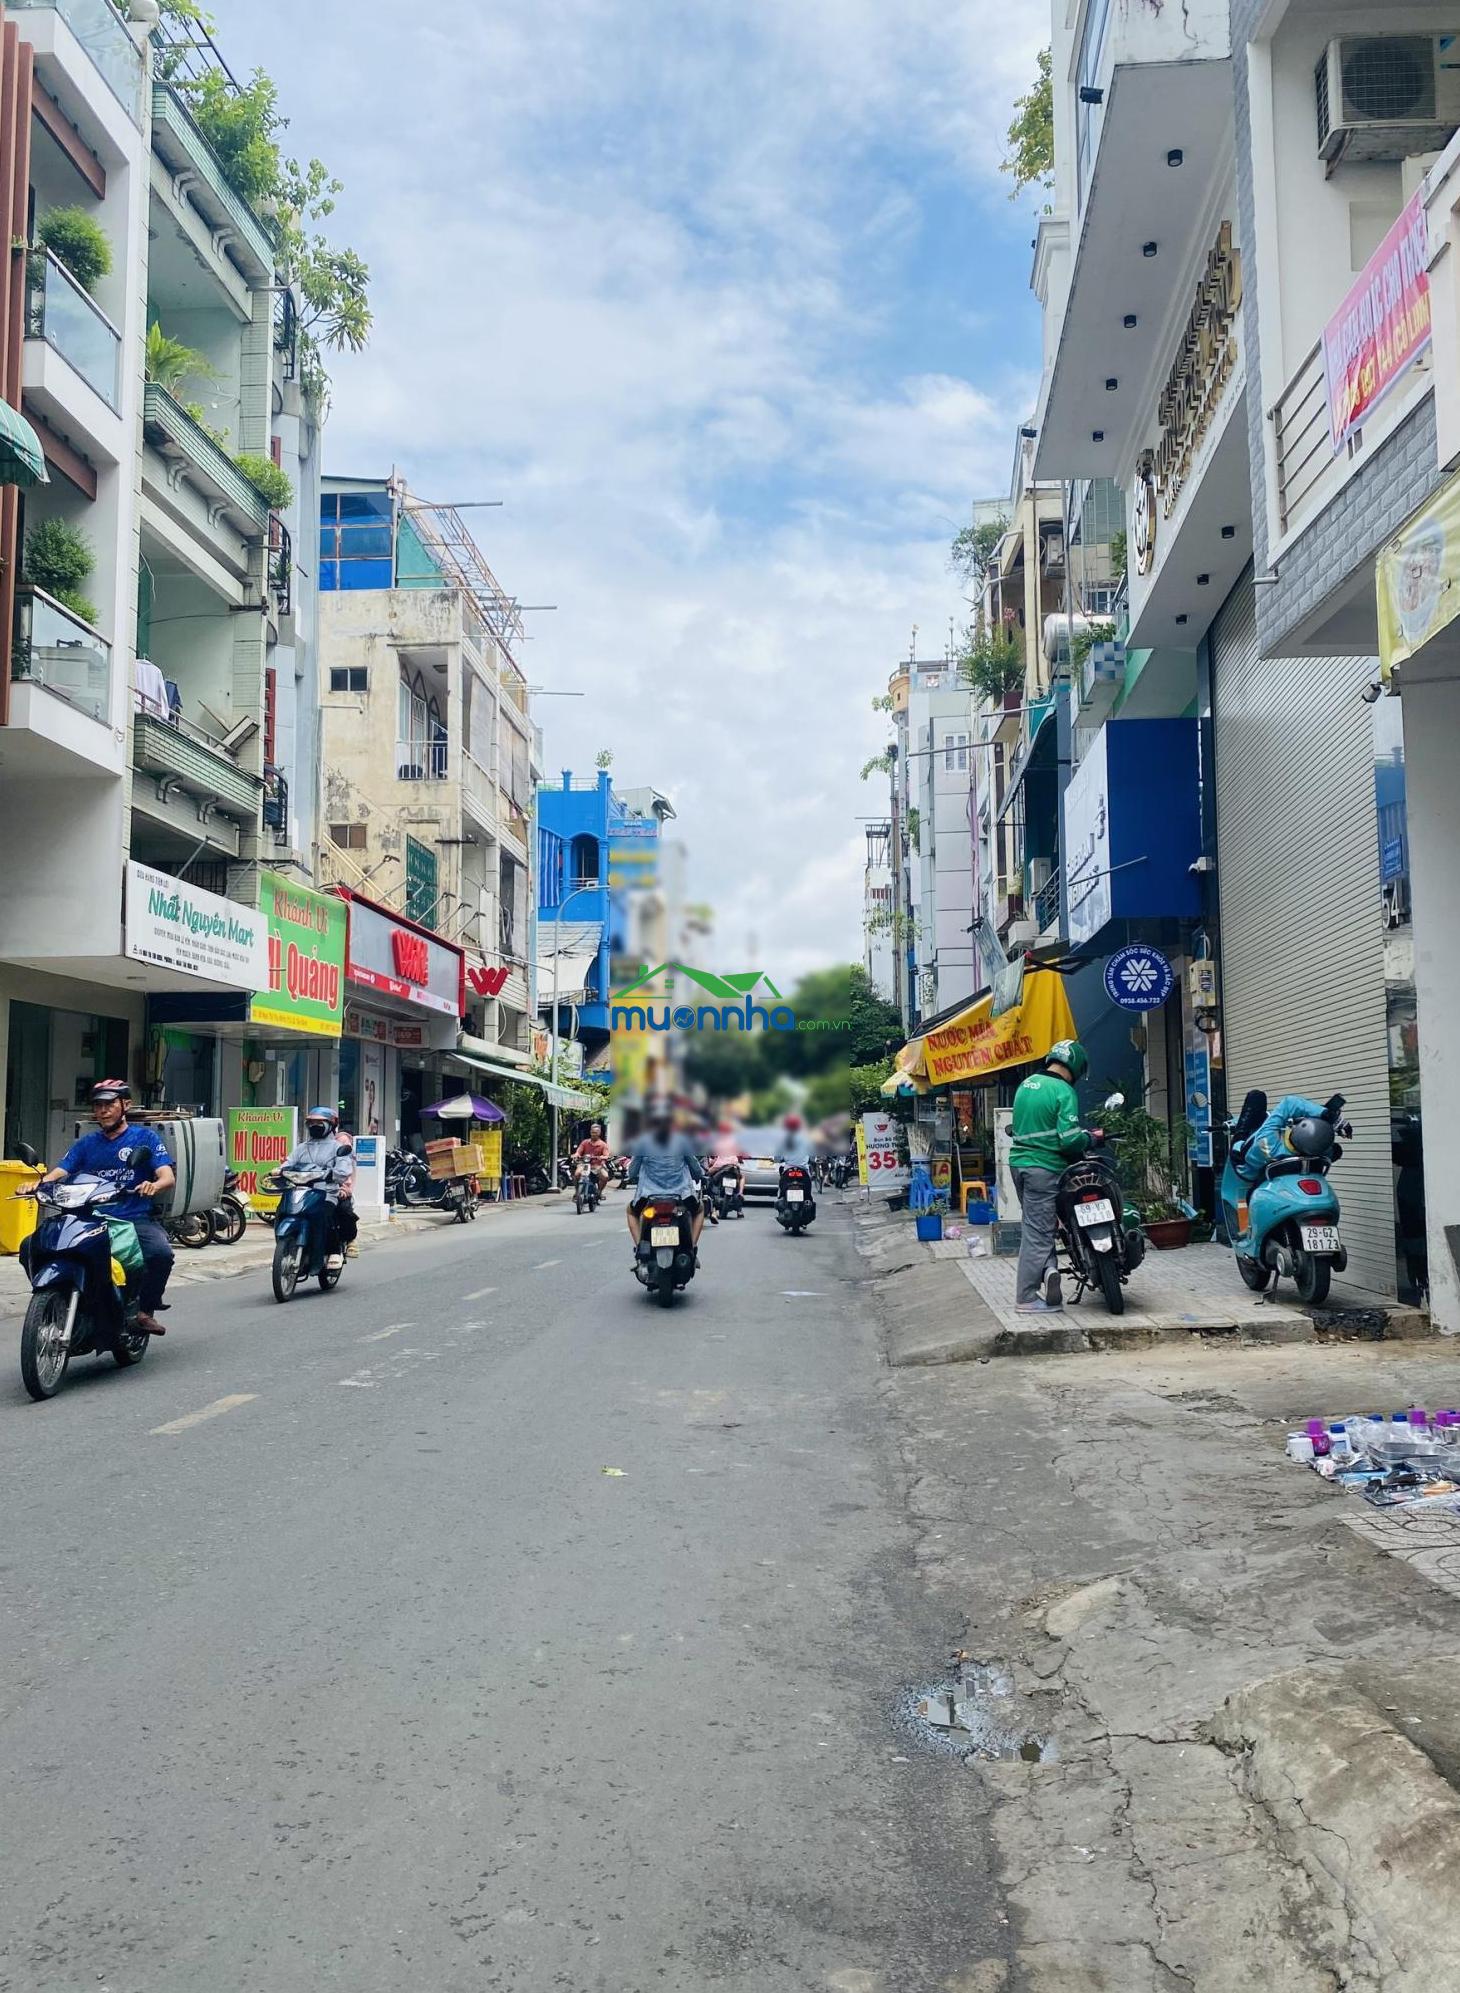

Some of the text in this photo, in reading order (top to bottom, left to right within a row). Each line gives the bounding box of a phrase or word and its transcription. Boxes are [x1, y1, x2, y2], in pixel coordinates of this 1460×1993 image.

[148, 887, 180, 922] Nhất
[182, 900, 226, 938] Nguyên
[228, 917, 254, 948] Mart
[274, 888, 313, 928] Khánh
[287, 943, 339, 1011] Quảng
[931, 1029, 1034, 1077] NGUYÊN CHẤT
